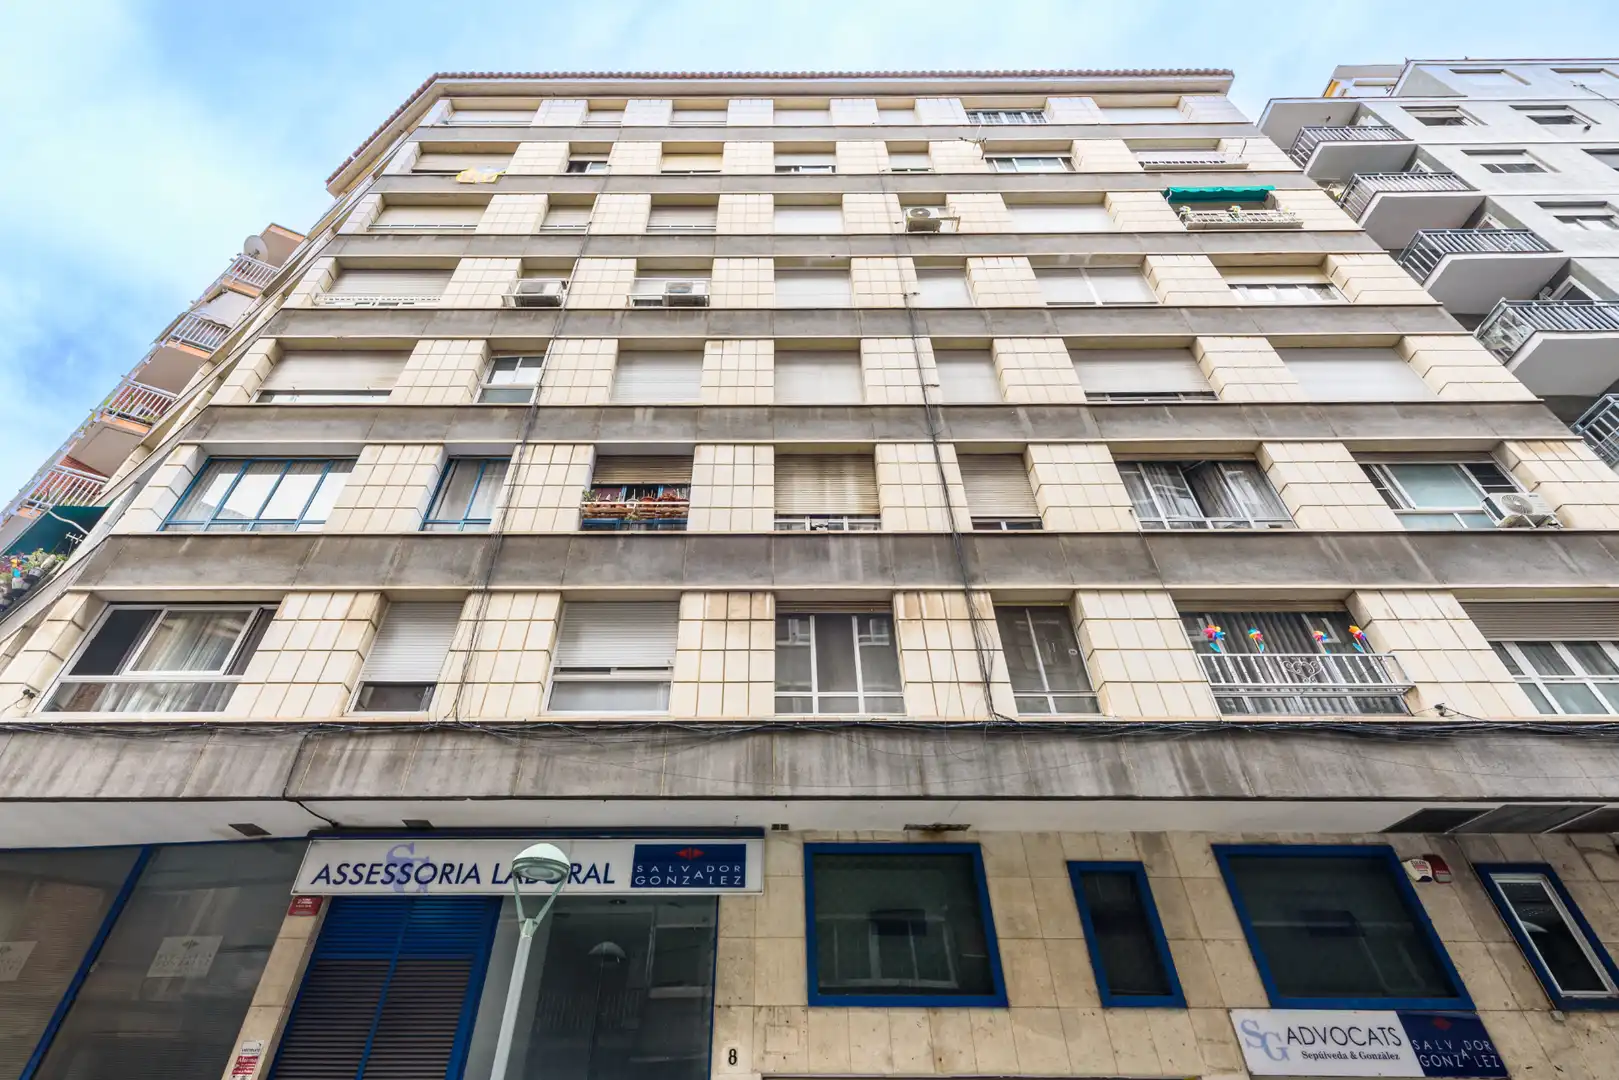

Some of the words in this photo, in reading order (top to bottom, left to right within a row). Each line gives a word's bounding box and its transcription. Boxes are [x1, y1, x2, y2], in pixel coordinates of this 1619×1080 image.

[310, 862, 481, 885] ASSESSORIA
[1287, 1026, 1402, 1047] ADVOCATS
[728, 1048, 738, 1065] 8
[1350, 1051, 1358, 1060] &
